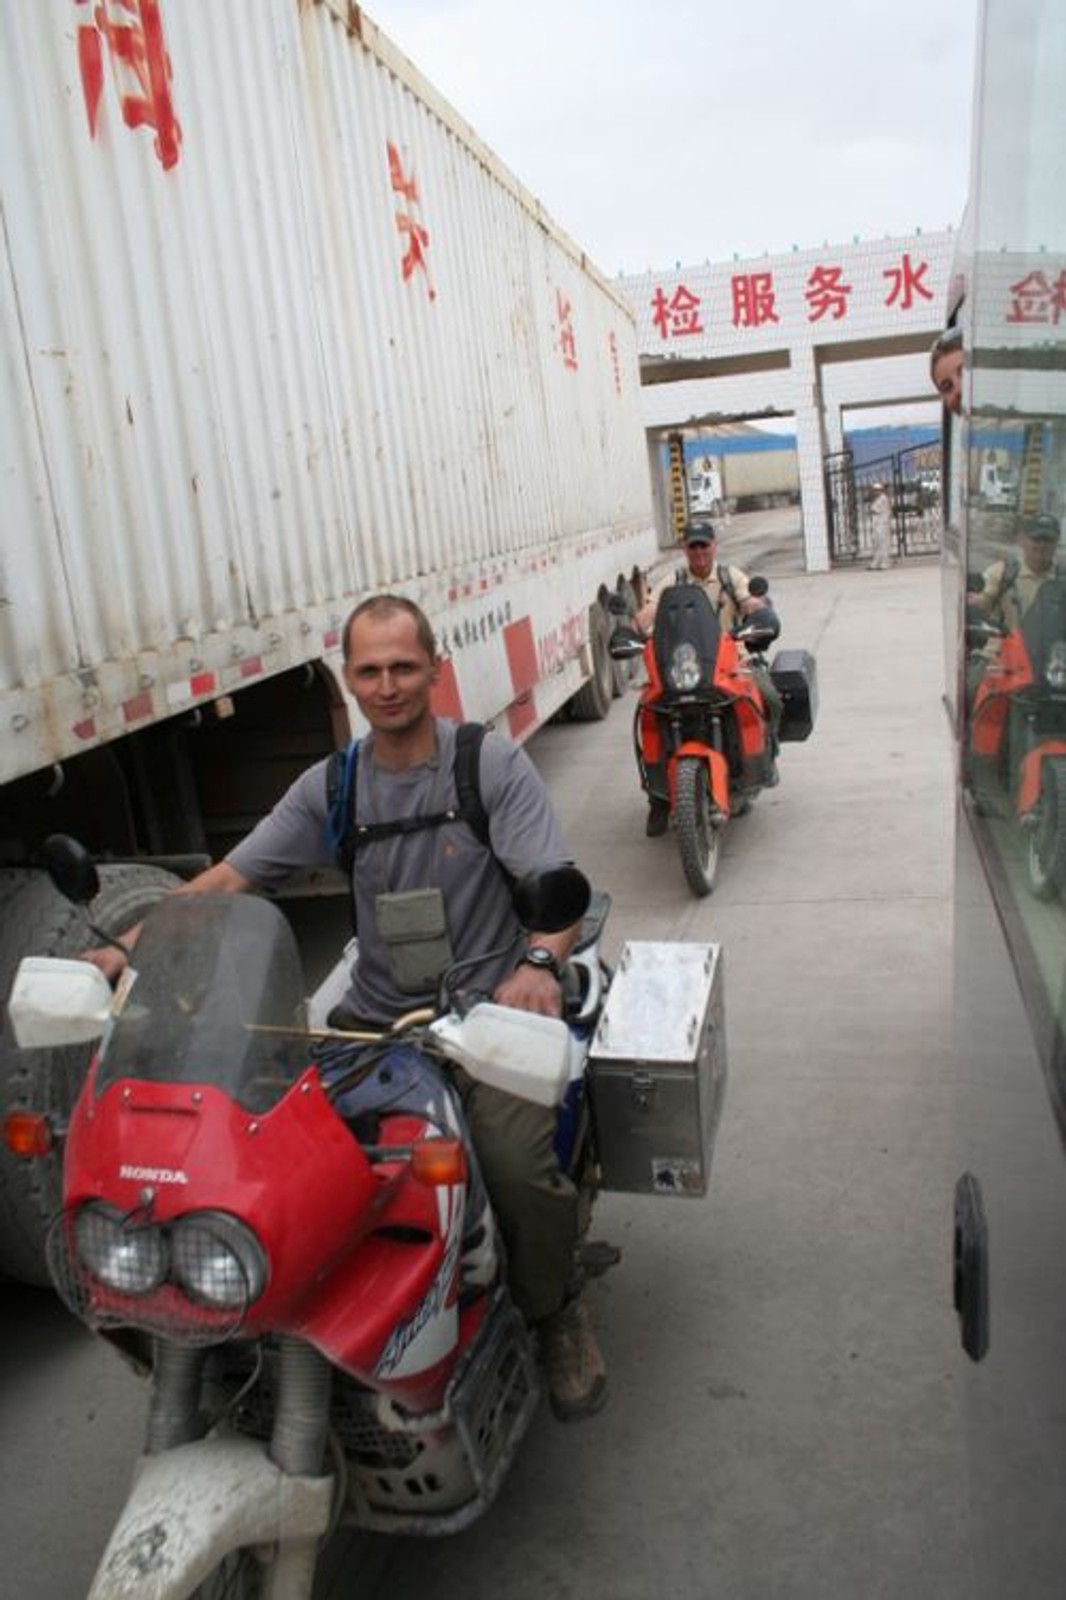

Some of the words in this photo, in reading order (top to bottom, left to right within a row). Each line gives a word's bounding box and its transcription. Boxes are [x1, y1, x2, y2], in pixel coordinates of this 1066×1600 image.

[650, 254, 934, 340] 检服务水
[119, 1164, 189, 1184] HONDA
